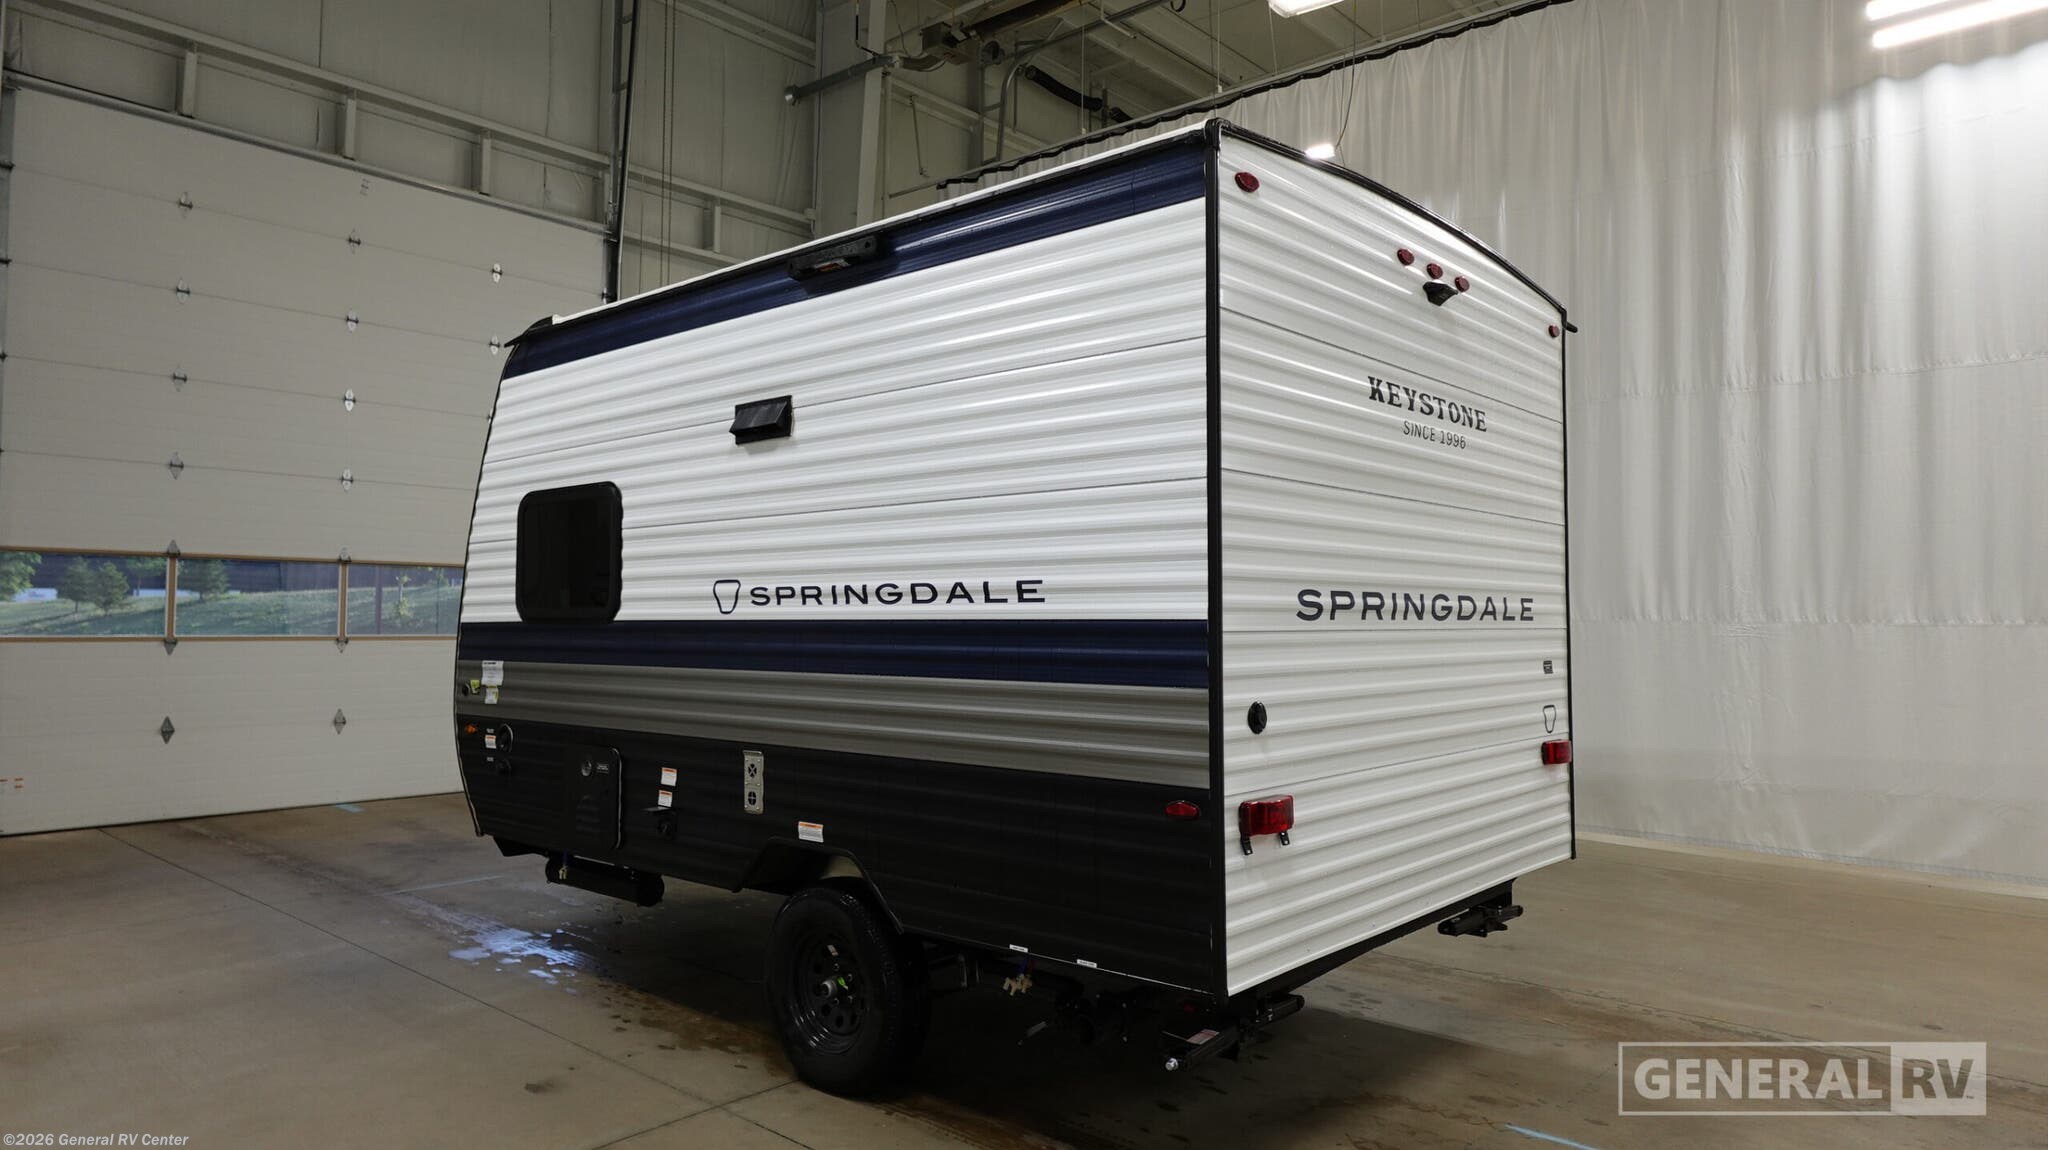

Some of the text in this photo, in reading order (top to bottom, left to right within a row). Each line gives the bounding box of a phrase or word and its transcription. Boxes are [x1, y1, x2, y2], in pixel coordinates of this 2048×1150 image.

[1367, 376, 1487, 433] KEYSTONE
[1402, 420, 1467, 449] SINCE 1996
[750, 580, 1046, 606] SPRINGDALE
[1296, 588, 1534, 621] SPRINGDALE
